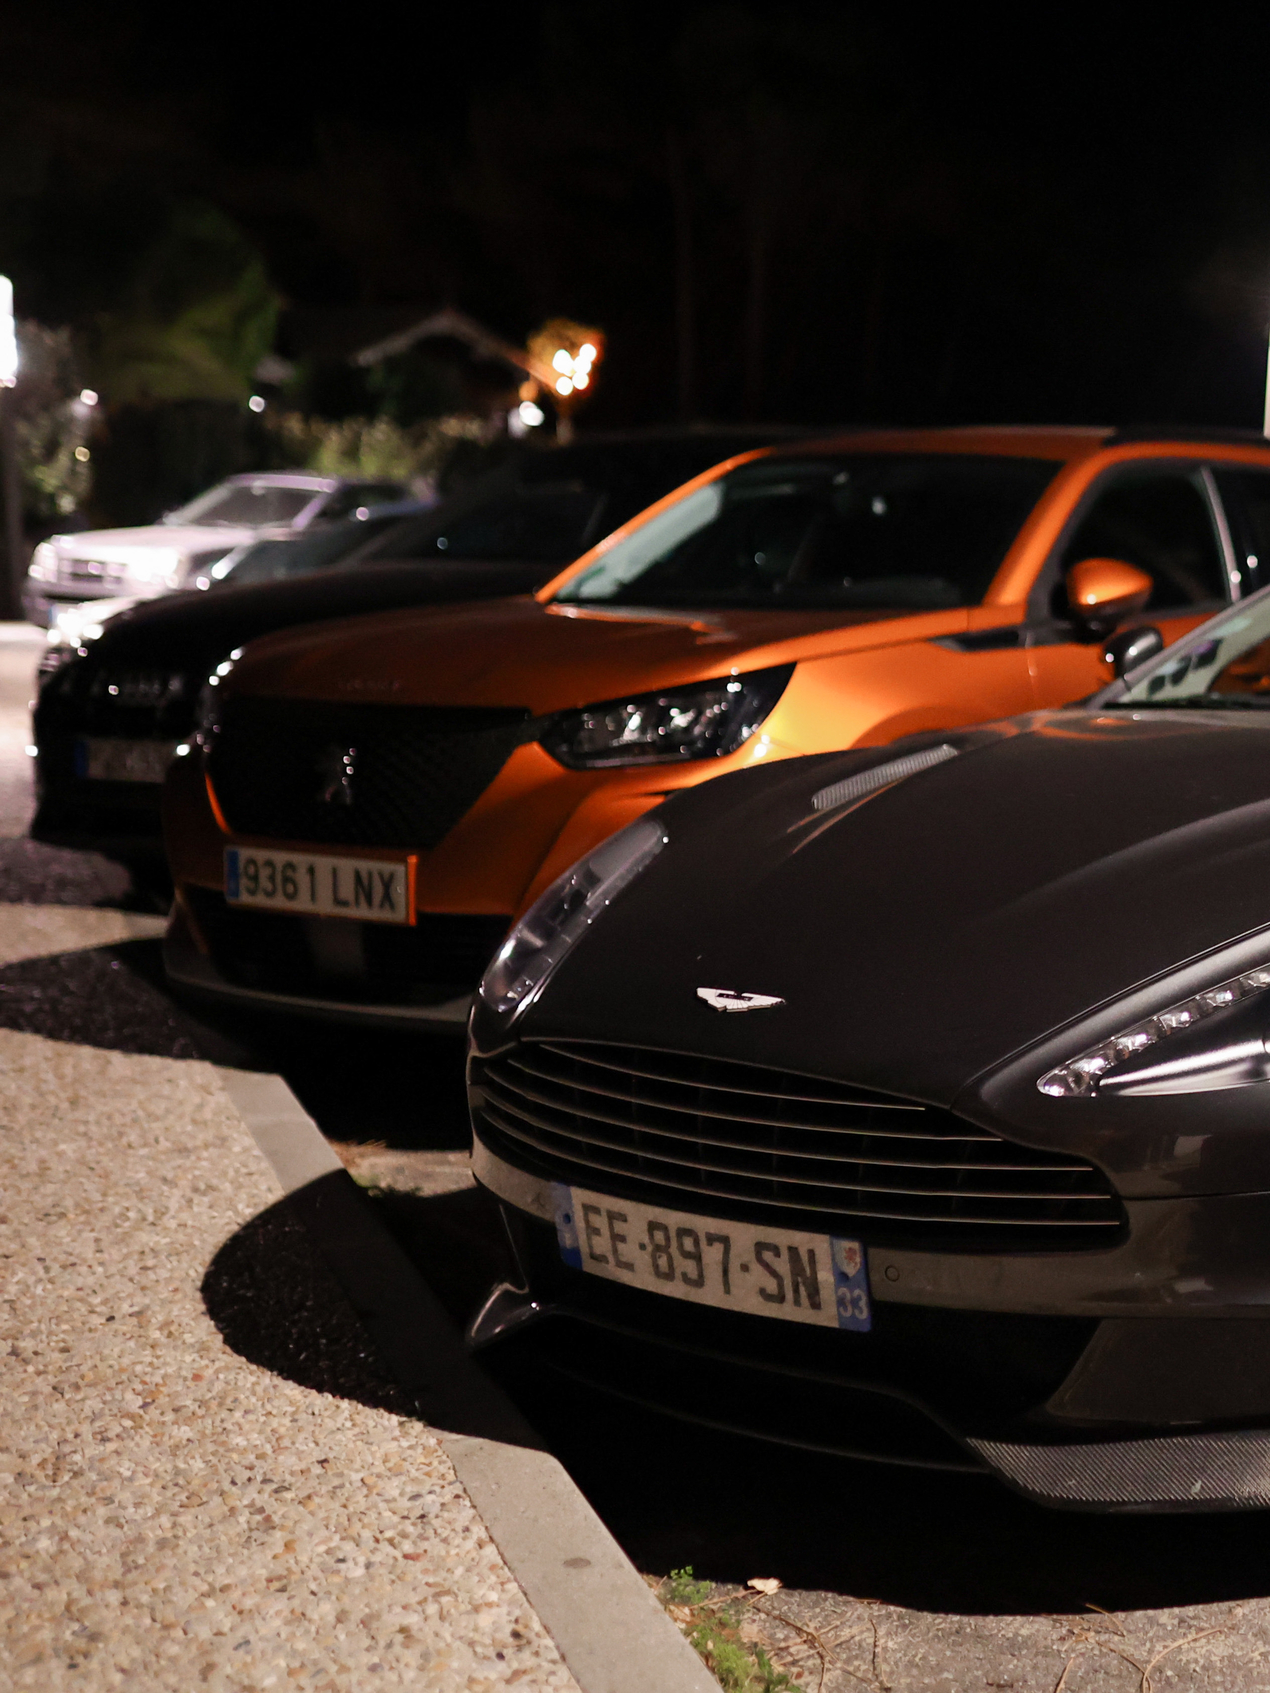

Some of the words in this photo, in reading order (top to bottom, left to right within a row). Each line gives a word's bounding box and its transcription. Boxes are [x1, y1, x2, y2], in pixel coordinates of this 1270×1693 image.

[243, 857, 316, 904] 9361
[331, 867, 395, 911] LNX
[838, 1287, 869, 1320] 33
